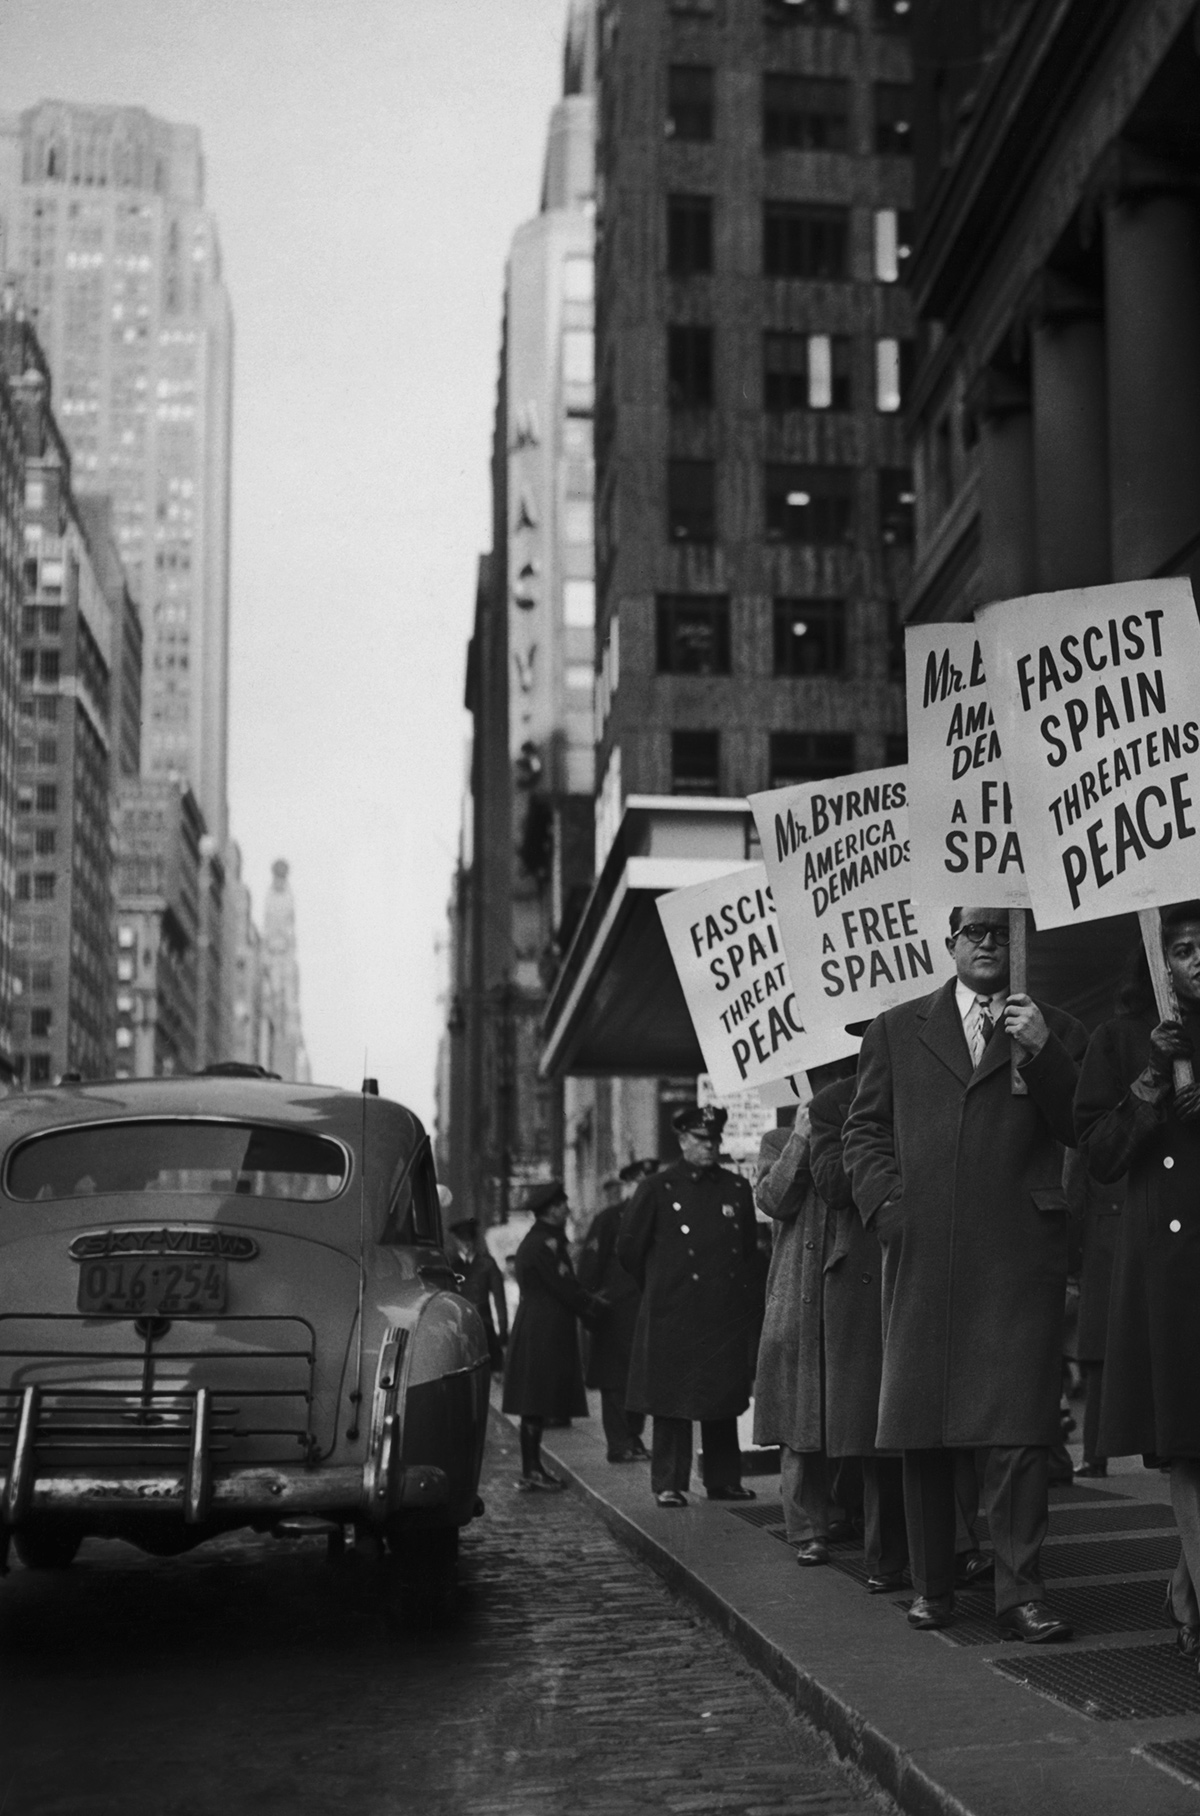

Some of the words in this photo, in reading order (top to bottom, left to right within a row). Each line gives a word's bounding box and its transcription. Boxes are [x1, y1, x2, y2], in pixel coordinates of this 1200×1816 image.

[923, 647, 967, 709] Mr.
[1016, 609, 1164, 712] FASCIST
[1040, 669, 1167, 768] SPAIN
[1048, 721, 1200, 836] THREATENS
[774, 808, 812, 863] Mr.
[951, 798, 967, 824] A
[804, 819, 896, 891] AMERICA
[822, 933, 836, 954] A
[841, 898, 918, 949] FREE
[821, 939, 934, 997] SPAIN
[85, 1231, 239, 1254] SKY-VIEW
